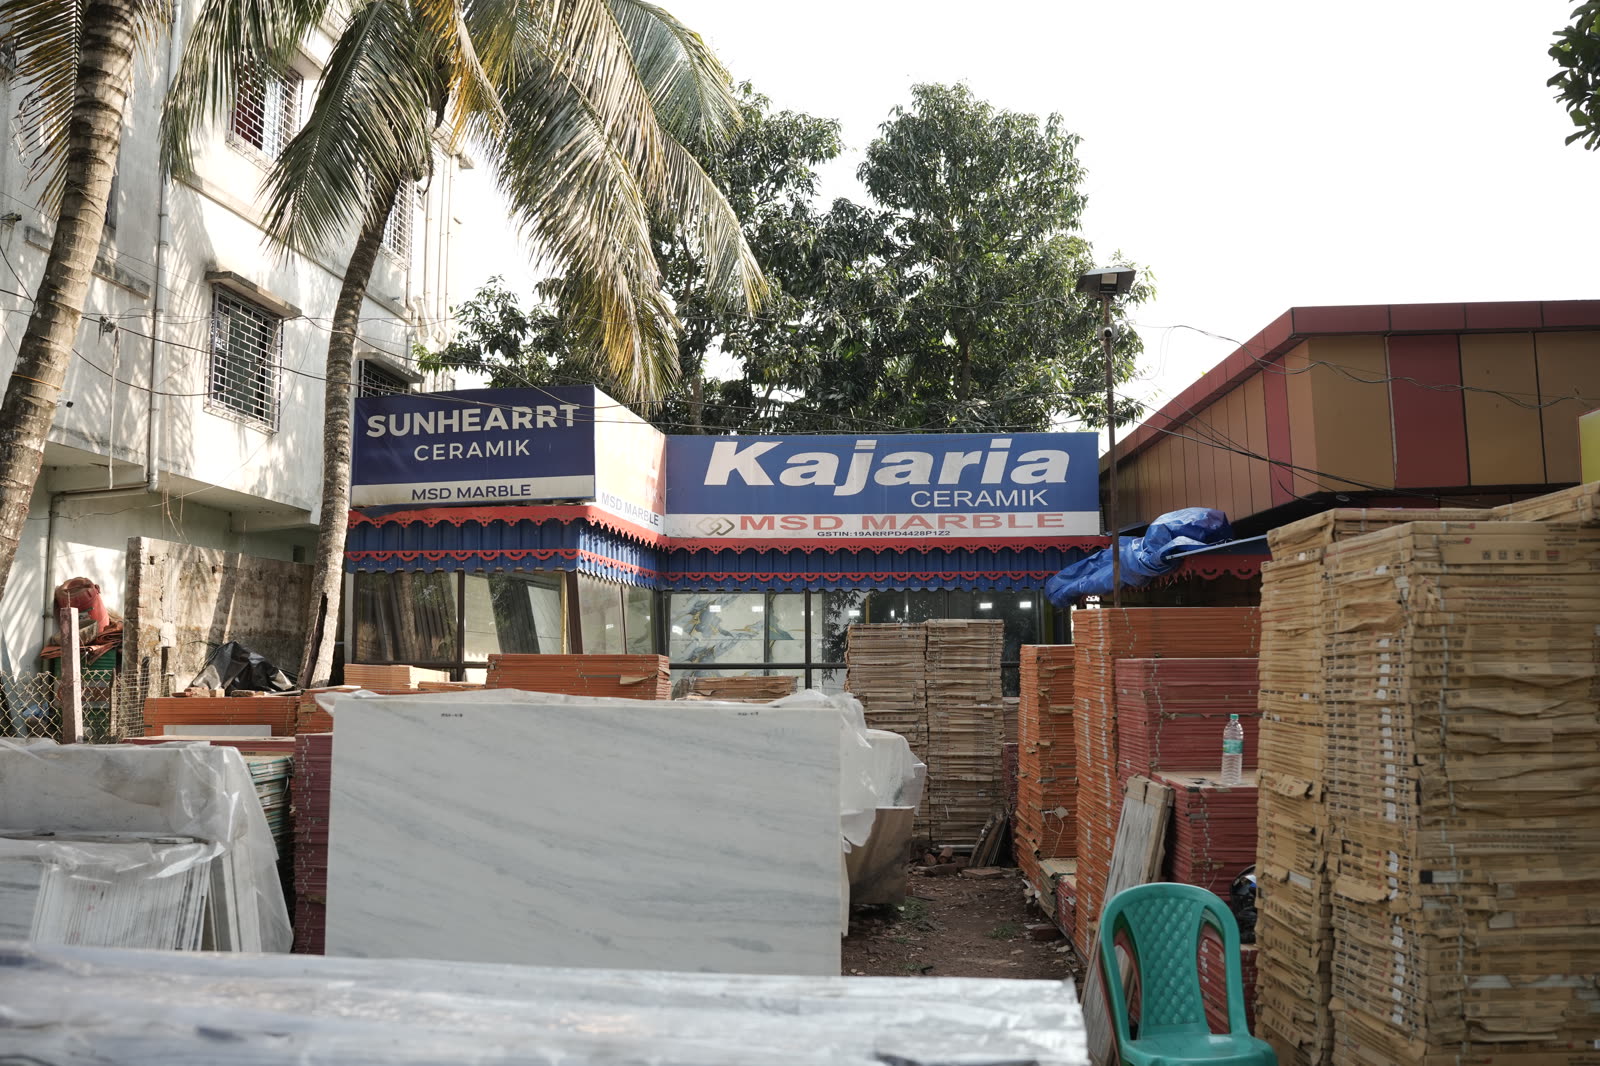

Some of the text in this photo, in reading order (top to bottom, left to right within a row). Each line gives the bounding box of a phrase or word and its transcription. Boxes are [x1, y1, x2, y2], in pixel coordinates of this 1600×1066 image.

[366, 403, 580, 438] SUNHEARRT
[414, 439, 531, 461] CERAMIK
[704, 438, 1070, 496] Kajaria
[412, 484, 531, 501] MSD MARBLE
[909, 489, 1048, 508] CERAMIK
[602, 492, 623, 511] MSD
[624, 502, 659, 526] MARBLE
[740, 513, 1064, 531] MSD MARBLE
